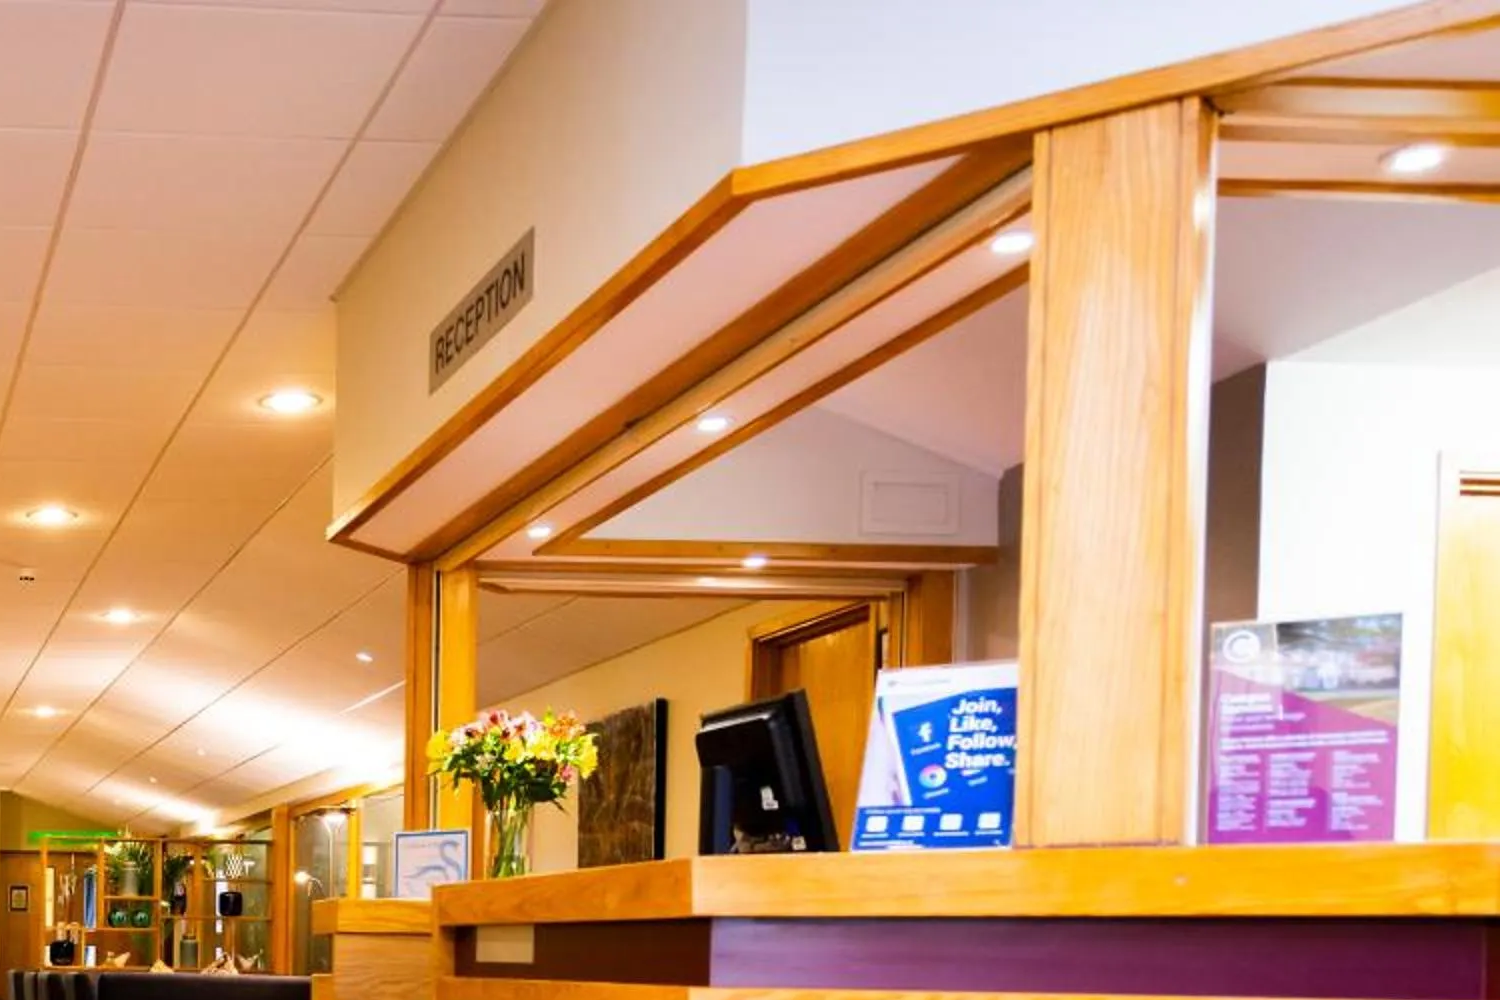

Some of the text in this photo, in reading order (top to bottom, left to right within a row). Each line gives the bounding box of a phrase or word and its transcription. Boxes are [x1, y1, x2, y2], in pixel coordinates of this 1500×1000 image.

[435, 251, 525, 374] RECEPTION
[951, 696, 1002, 715] Join,
[948, 716, 998, 732] Like,
[944, 751, 1010, 768] Share.
